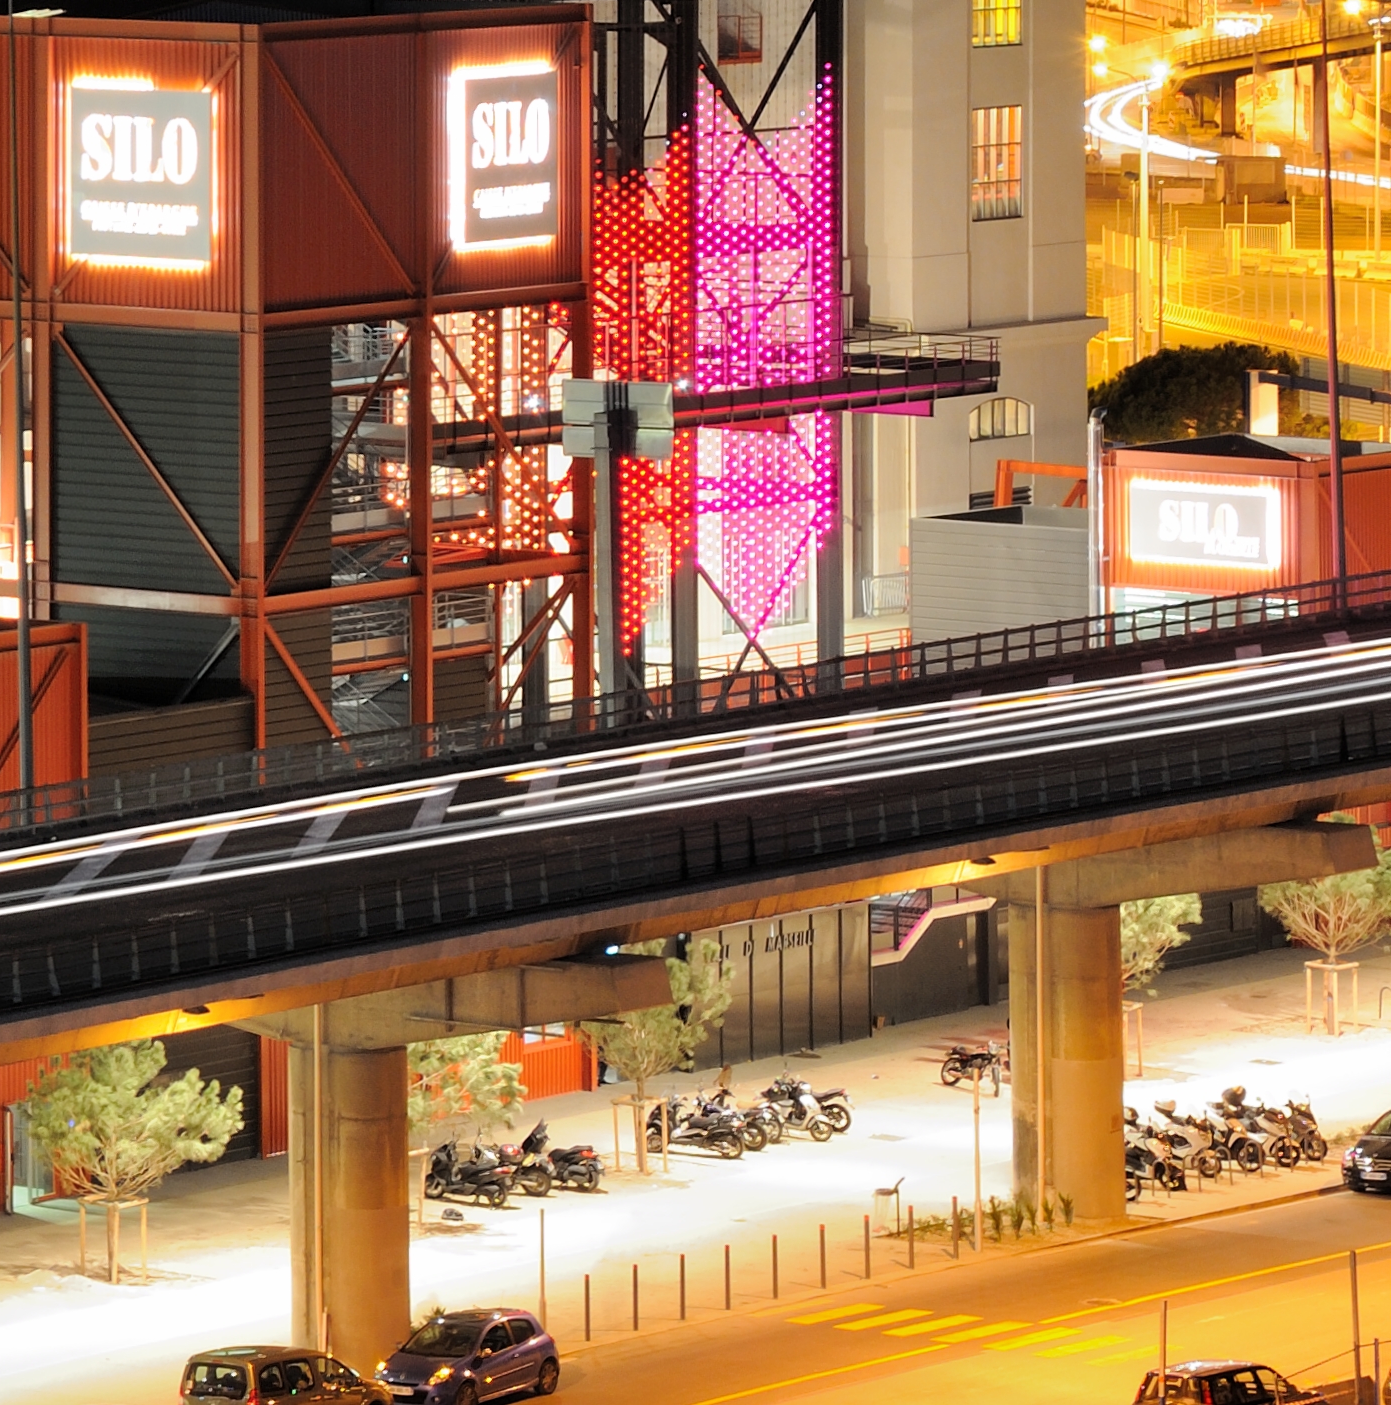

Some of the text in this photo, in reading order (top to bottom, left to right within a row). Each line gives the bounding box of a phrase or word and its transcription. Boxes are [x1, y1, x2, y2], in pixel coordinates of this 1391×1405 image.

[80, 113, 198, 185] SILO
[471, 98, 550, 169] SILO
[1158, 499, 1238, 543] SILO
